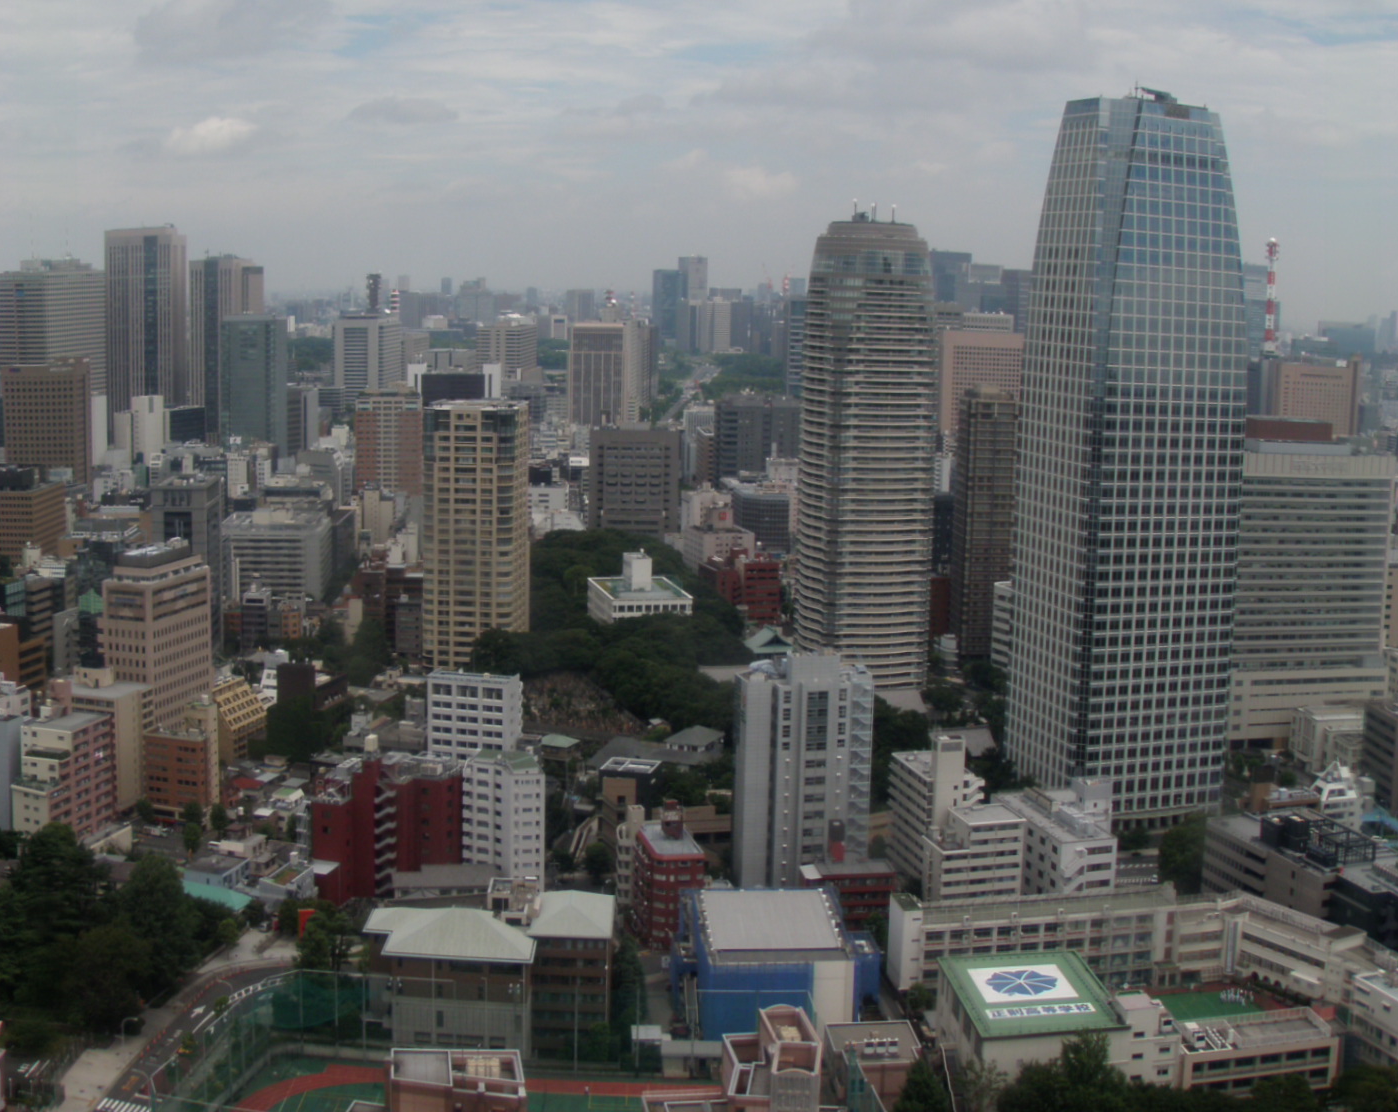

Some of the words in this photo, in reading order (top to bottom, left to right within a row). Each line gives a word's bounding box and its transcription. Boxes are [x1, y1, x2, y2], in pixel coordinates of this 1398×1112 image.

[991, 1003, 1091, 1018] 正則高等学校
